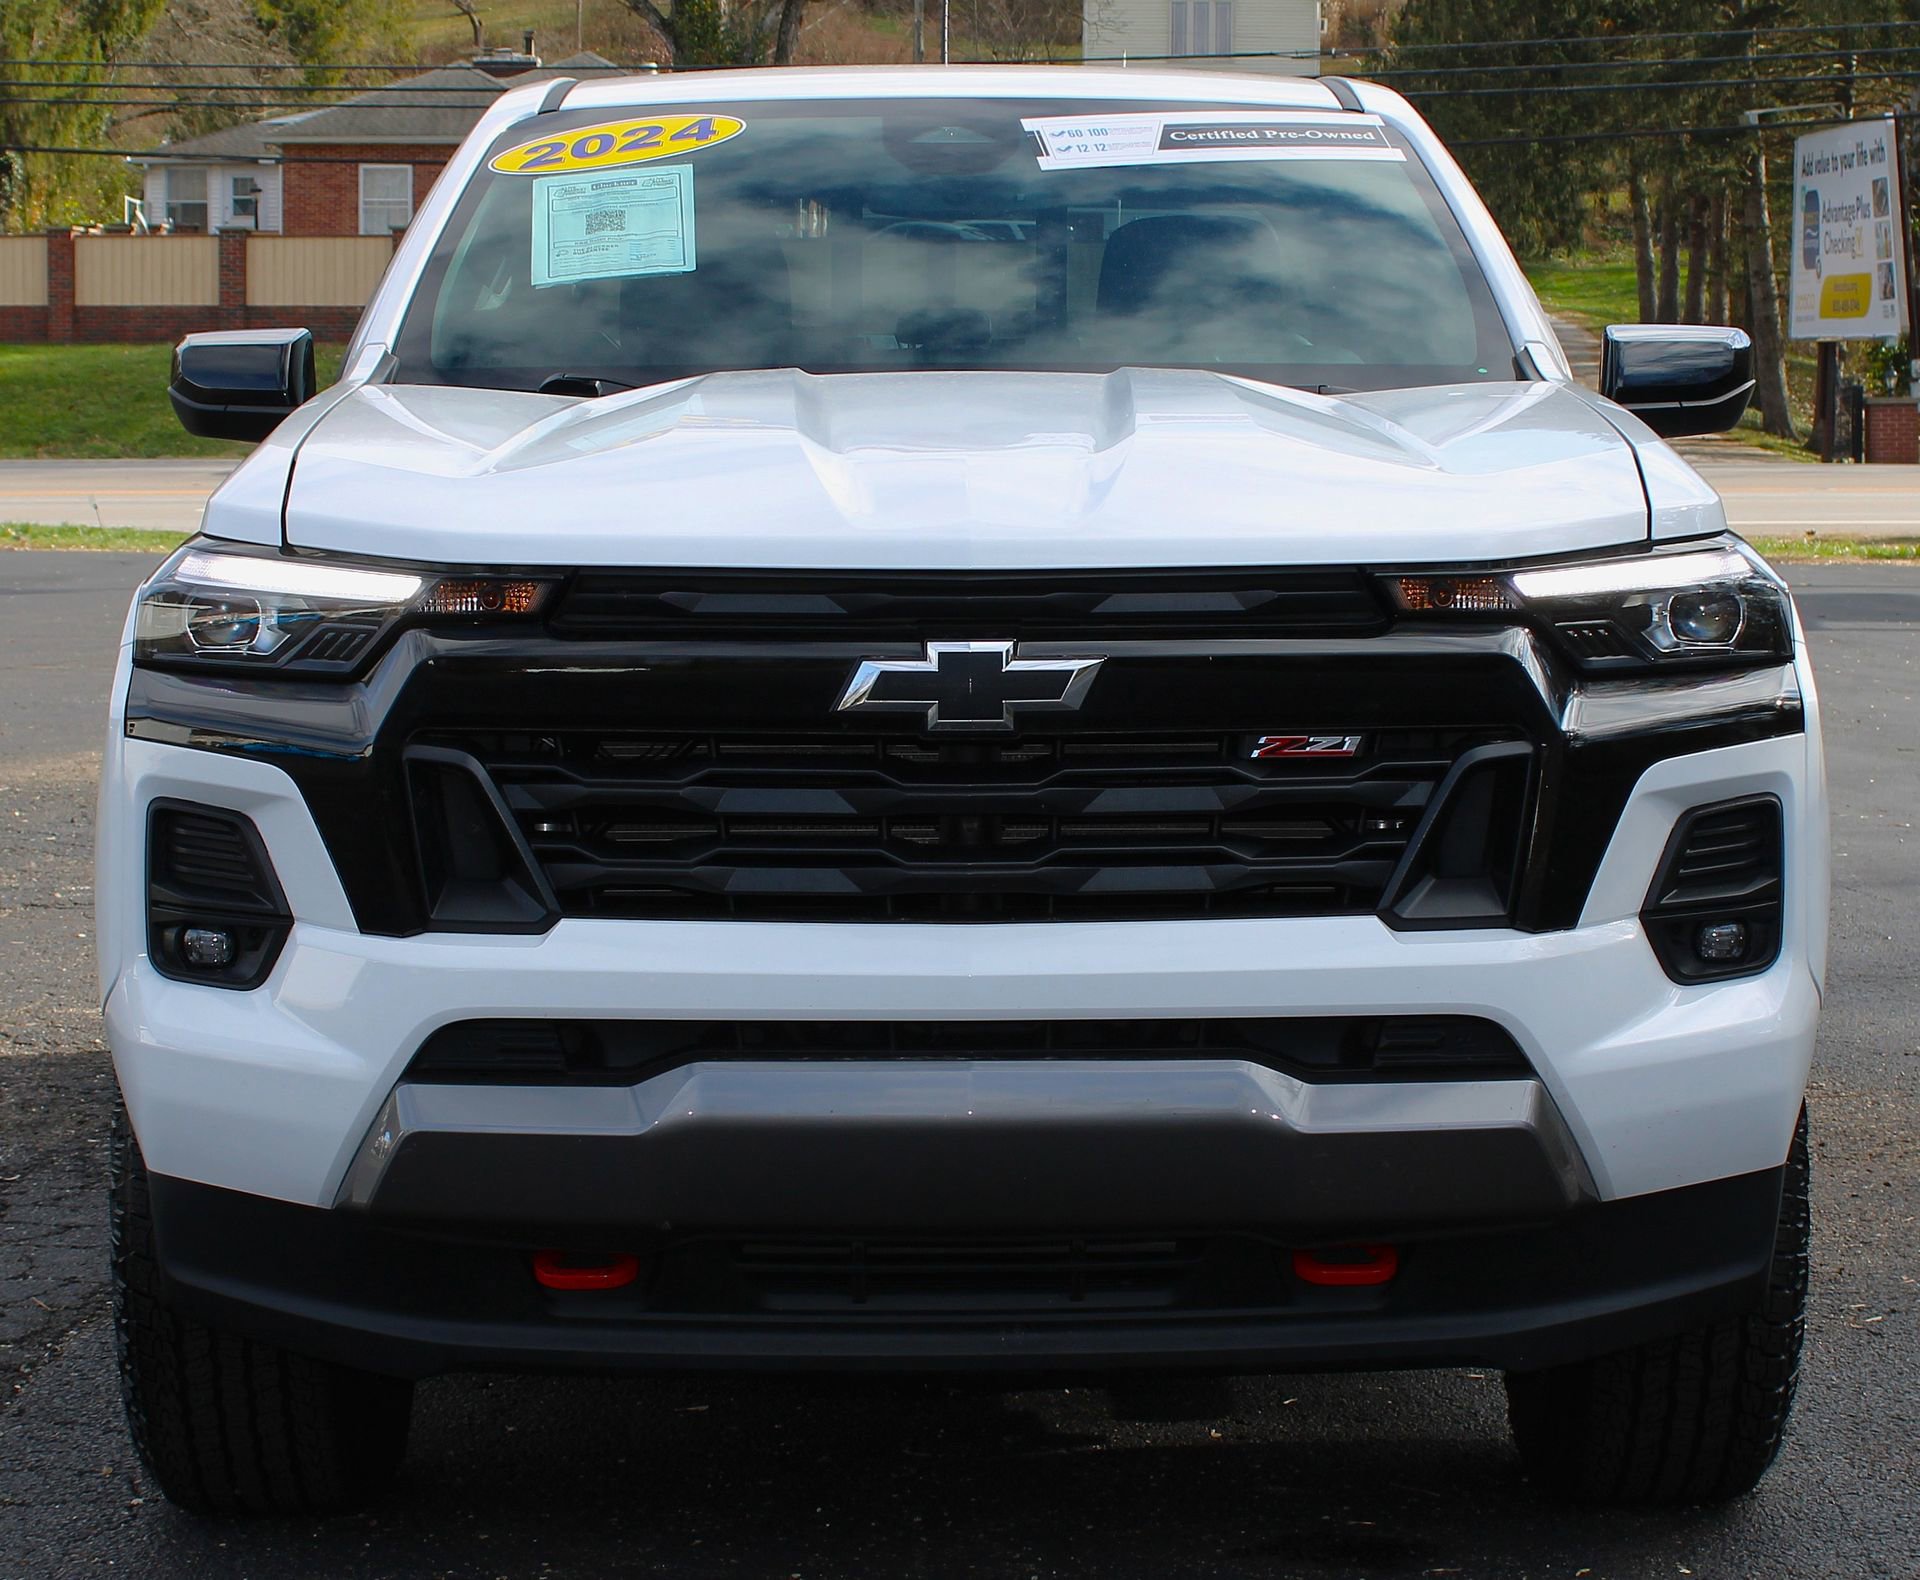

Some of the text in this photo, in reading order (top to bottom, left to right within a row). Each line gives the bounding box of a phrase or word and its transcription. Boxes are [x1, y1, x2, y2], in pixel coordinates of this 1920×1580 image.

[1067, 129, 1083, 138] 60
[1087, 128, 1109, 137] 100
[1169, 128, 1376, 142] Certified Pre-Owned
[518, 118, 719, 171] 2024
[1076, 144, 1089, 153] 12
[1095, 143, 1108, 152] 12
[1802, 137, 1886, 178] Add value to your life with
[1824, 228, 1856, 259] Checking
